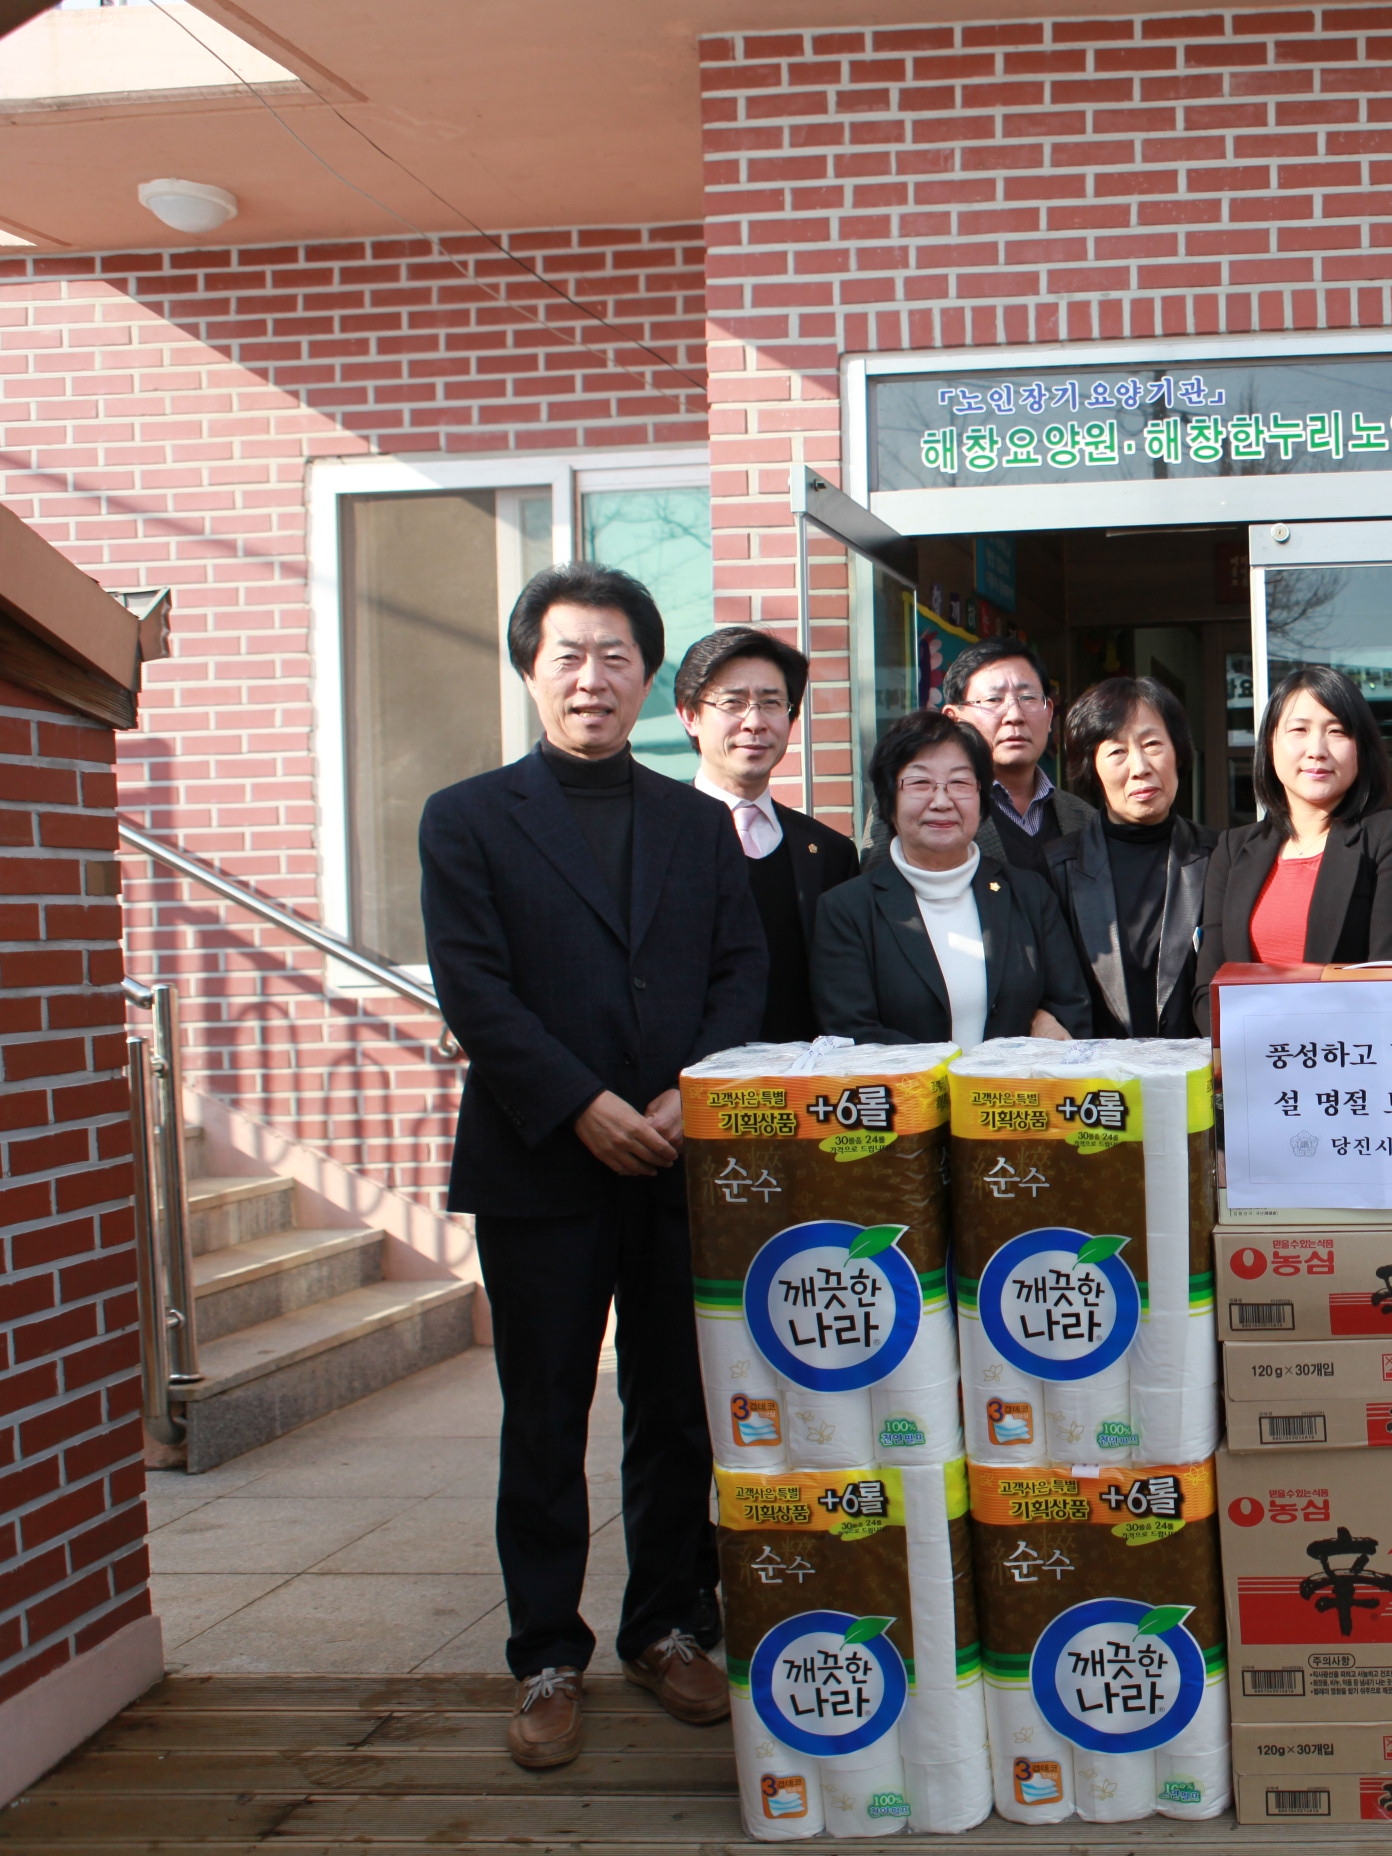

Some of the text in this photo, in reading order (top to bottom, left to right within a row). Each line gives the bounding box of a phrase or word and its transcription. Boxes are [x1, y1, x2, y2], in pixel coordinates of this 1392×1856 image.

[1265, 1040, 1377, 1070] 풍성하고
[708, 1089, 785, 1107] 고객사은 특별
[809, 1086, 890, 1127] +6롤
[971, 1092, 1038, 1105] 고객사은 특별
[1058, 1091, 1124, 1127] +6롤
[1274, 1090, 1301, 1117] 설
[1316, 1089, 1369, 1116] 명절
[719, 1111, 796, 1135] 기획상품
[981, 1110, 1047, 1129] 기획상품
[714, 1157, 782, 1203] 순수
[983, 1157, 1050, 1198] 순수
[1271, 1250, 1335, 1277] 농심
[778, 1267, 882, 1311] 깨끗한
[1013, 1268, 1105, 1307] 깨끗한
[789, 1311, 880, 1348] 나라
[1021, 1309, 1100, 1343] 나라
[736, 1486, 799, 1500] 고객사은 특별
[820, 1482, 884, 1515] +6롤
[1000, 1479, 1078, 1495] 고객사은 특별
[1101, 1476, 1178, 1515] +6롤
[744, 1504, 809, 1522] 기획상품
[1012, 1499, 1089, 1520] 기획상품
[1268, 1499, 1330, 1523] 농심
[750, 1545, 816, 1584] 순수
[1003, 1541, 1075, 1583] 순수
[782, 1650, 872, 1685] 깨끗한
[1067, 1640, 1168, 1682] 깨끗한
[1313, 1656, 1350, 1666] 주의사항
[789, 1686, 871, 1718] 나라
[1076, 1683, 1164, 1715] 나라
